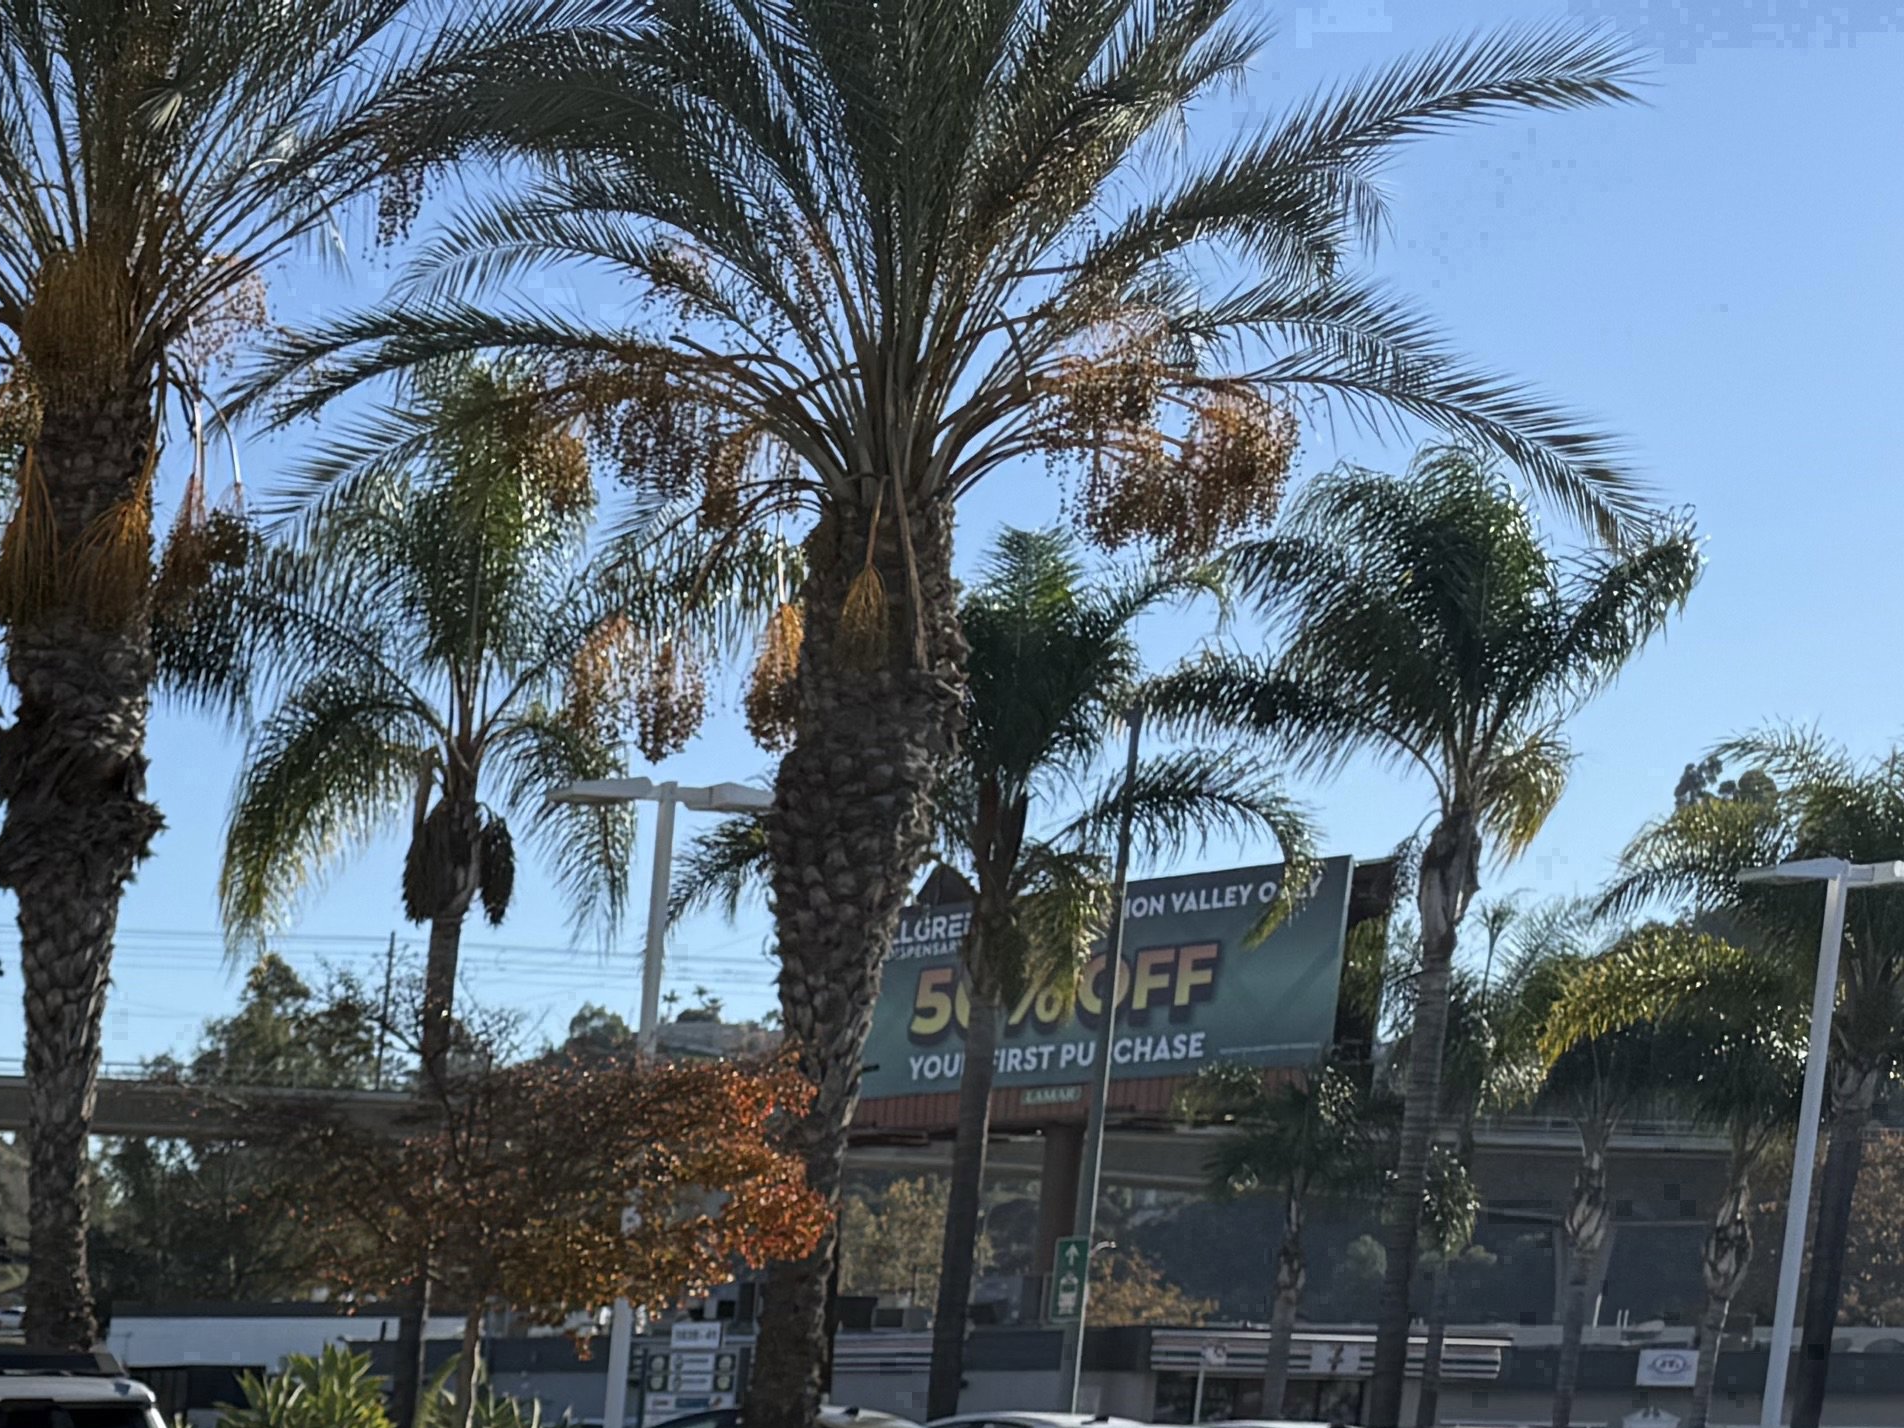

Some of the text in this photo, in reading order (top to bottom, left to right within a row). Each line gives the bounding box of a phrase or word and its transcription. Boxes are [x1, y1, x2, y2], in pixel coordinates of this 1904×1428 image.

[1171, 883, 1253, 914] VALLEY
[1257, 876, 1323, 903] OY
[1077, 943, 1218, 1015] OFF
[909, 1053, 965, 1081] YOU
[1060, 1032, 1206, 1070] PUCHASE
